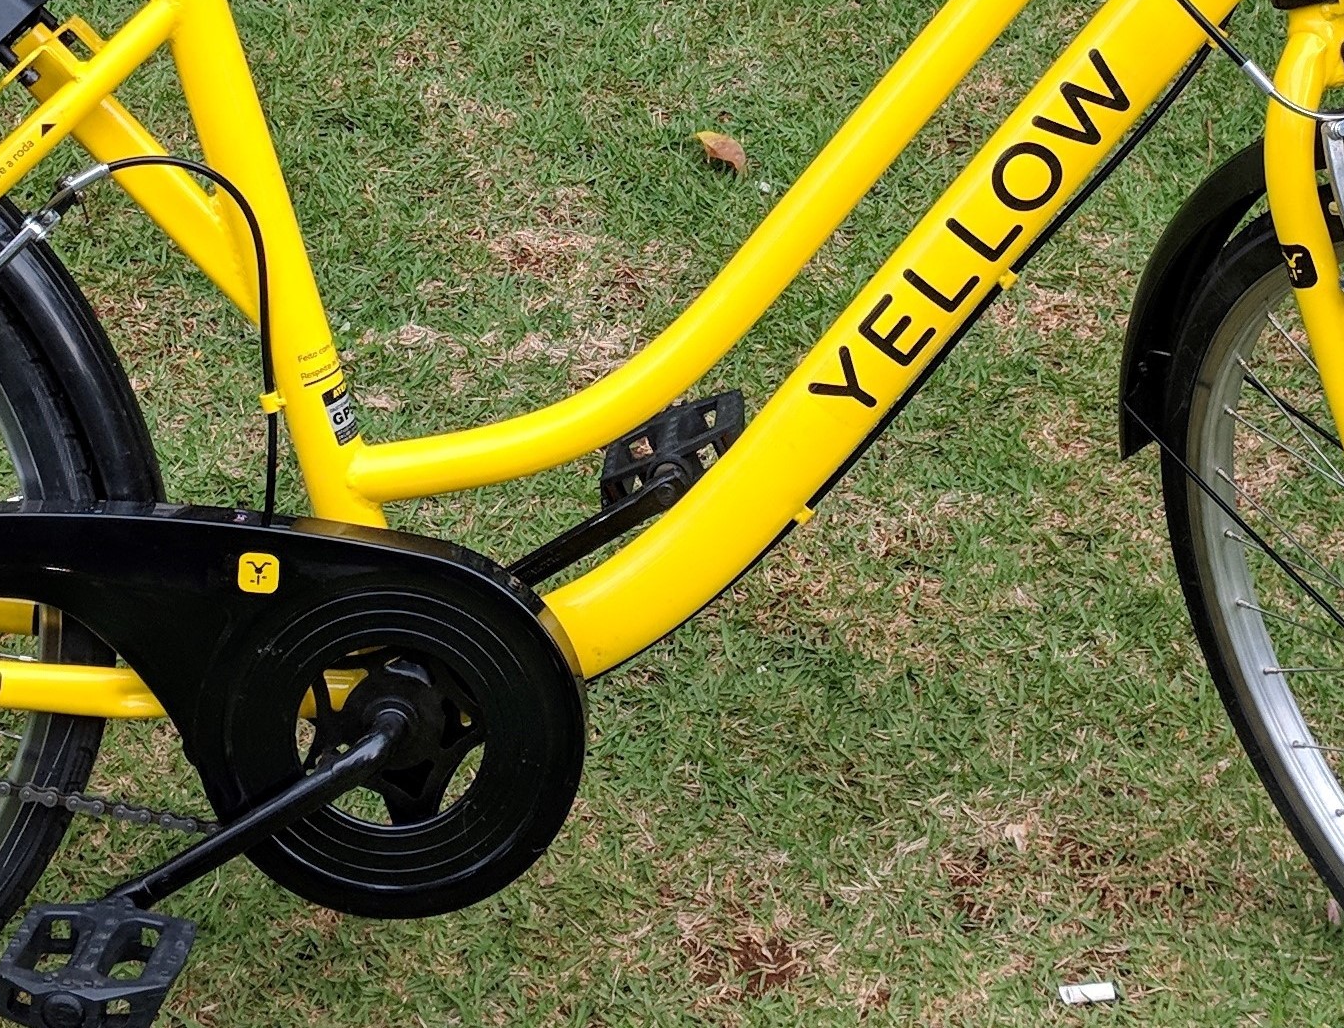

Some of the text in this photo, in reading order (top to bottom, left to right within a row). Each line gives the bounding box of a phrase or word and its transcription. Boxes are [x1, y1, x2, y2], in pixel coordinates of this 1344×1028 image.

[6, 160, 14, 168] a
[12, 140, 35, 161] roda
[807, 47, 1131, 411] YELLOW
